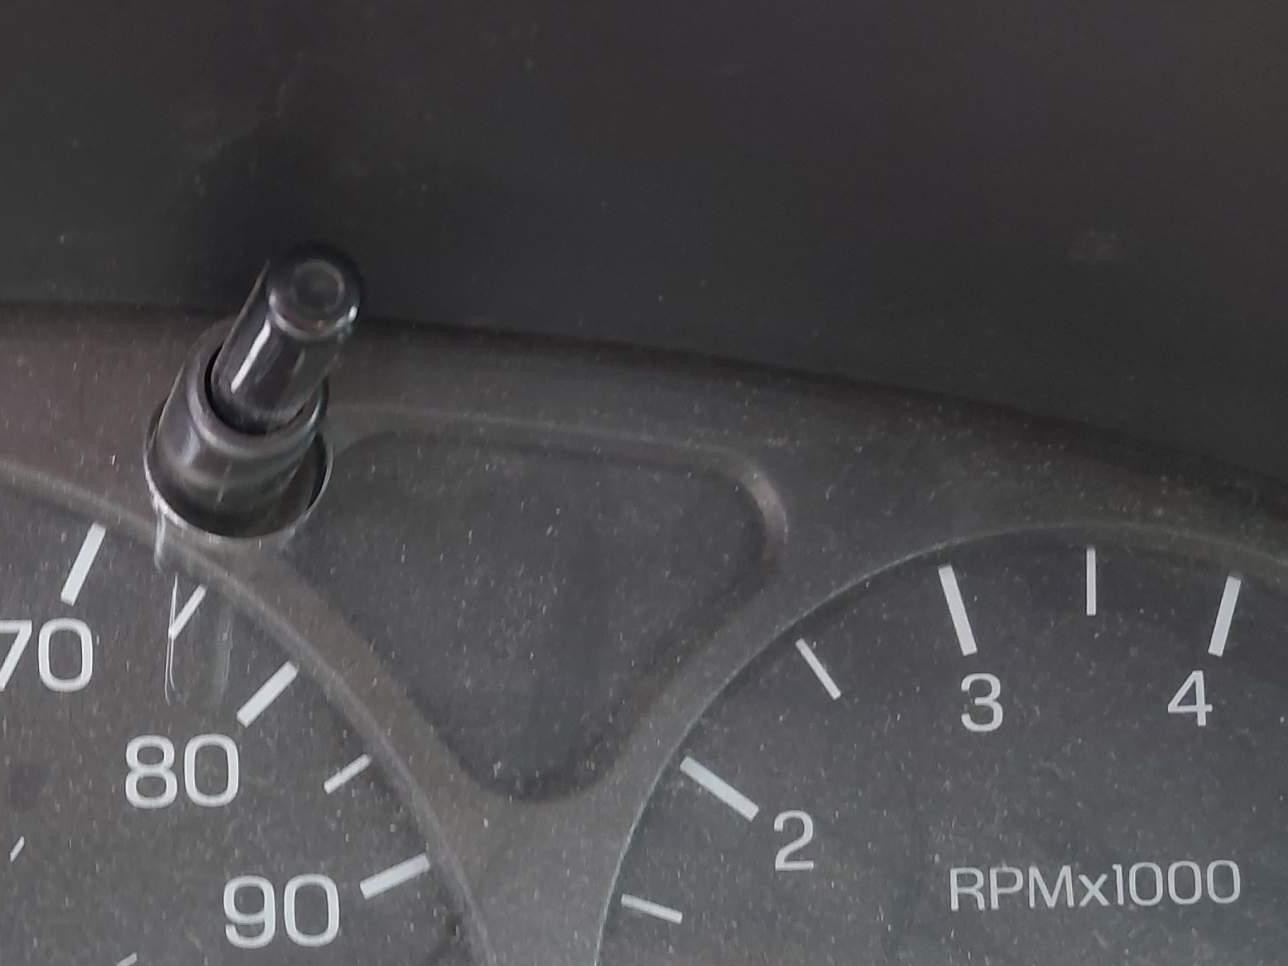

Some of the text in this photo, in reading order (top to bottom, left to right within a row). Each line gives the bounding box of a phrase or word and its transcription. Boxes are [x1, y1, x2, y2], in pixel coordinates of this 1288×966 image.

[960, 673, 1004, 733] 3
[1167, 670, 1213, 727] 4
[125, 734, 240, 808] 80
[773, 810, 815, 871] 2
[223, 873, 340, 948] 90
[949, 859, 1241, 912] RPMx1000
